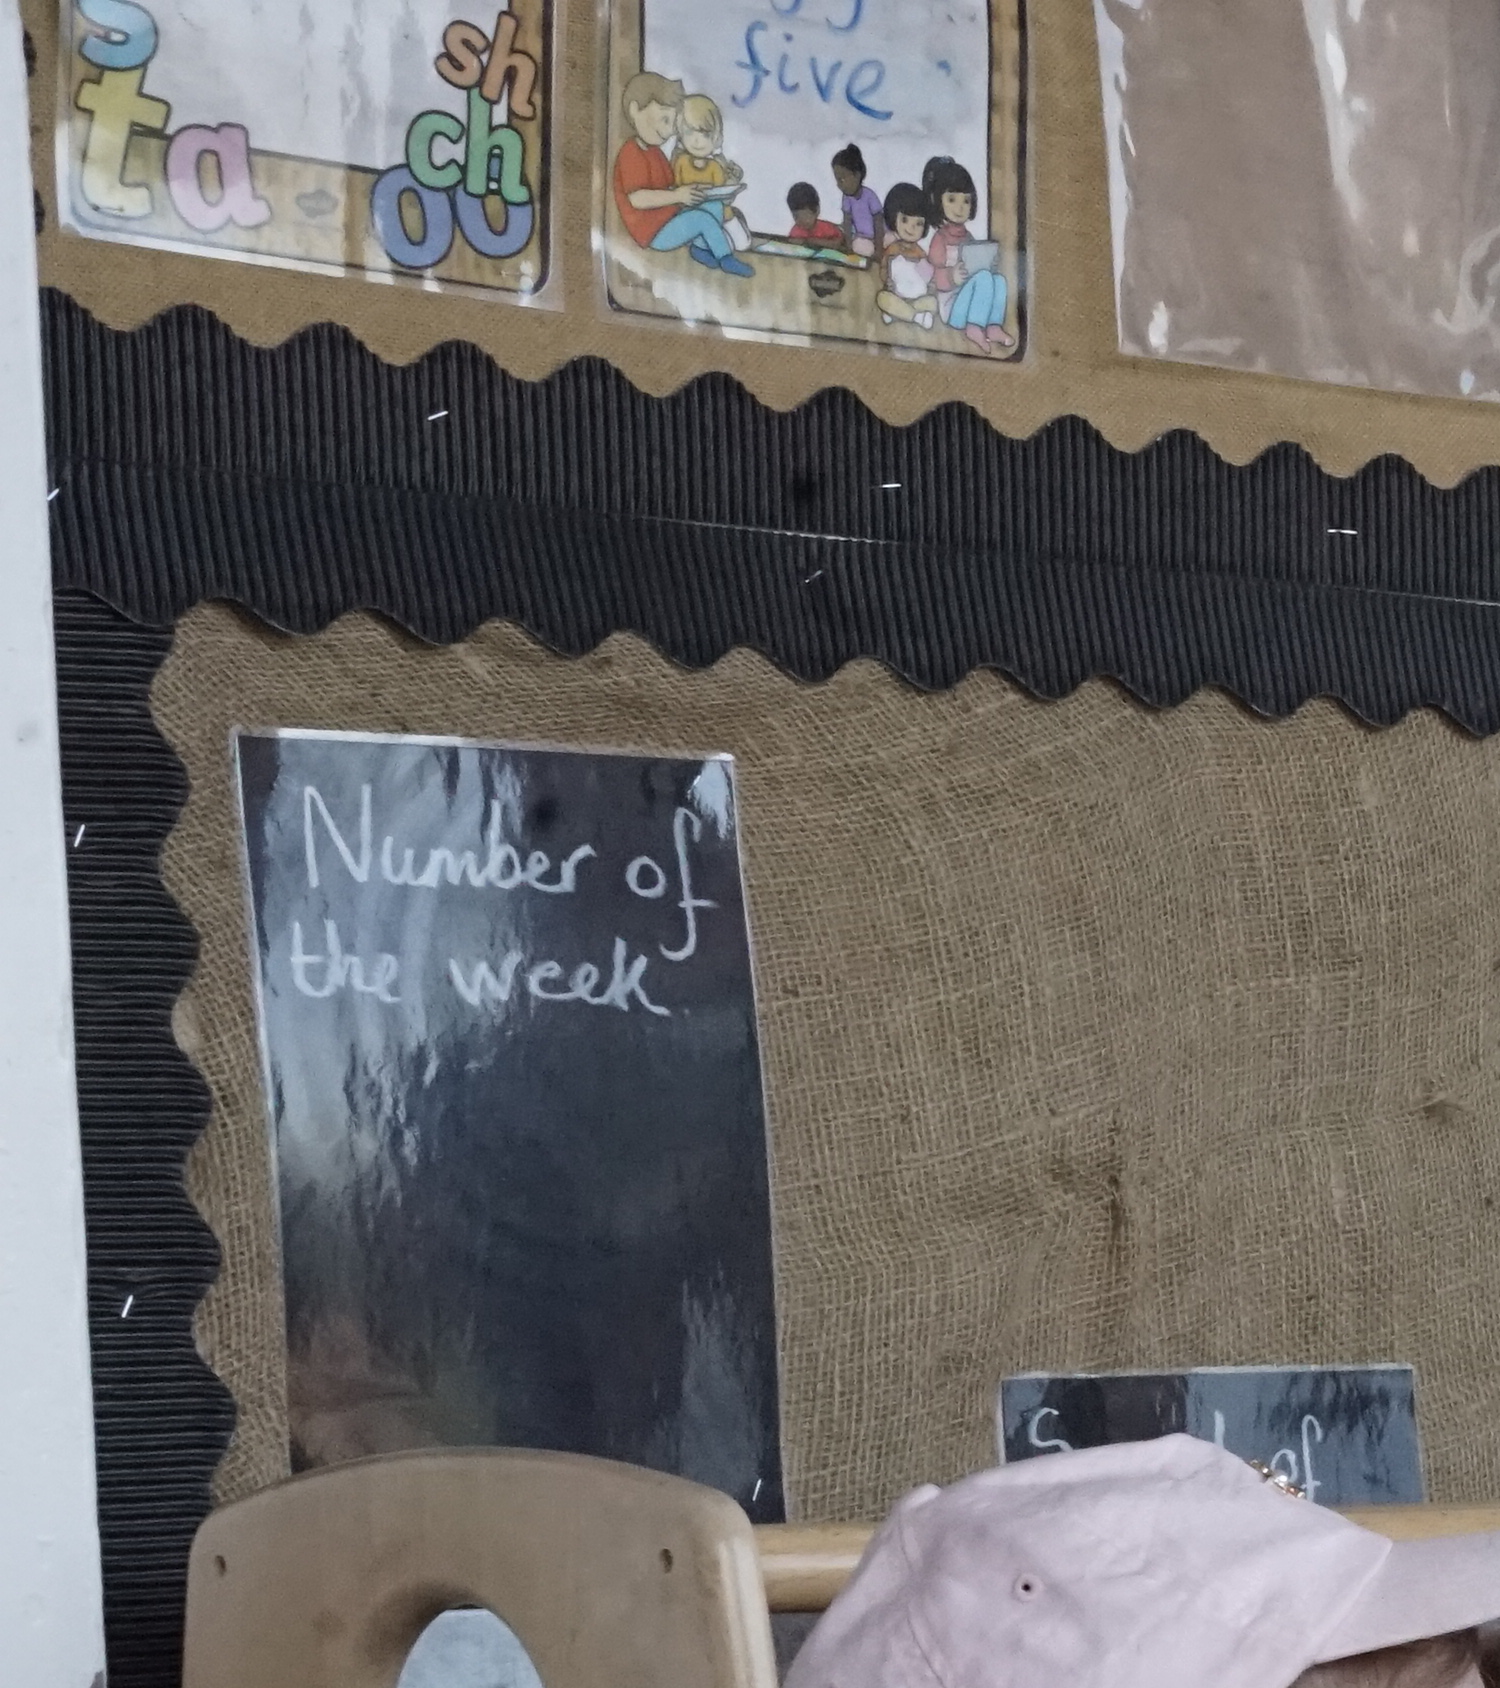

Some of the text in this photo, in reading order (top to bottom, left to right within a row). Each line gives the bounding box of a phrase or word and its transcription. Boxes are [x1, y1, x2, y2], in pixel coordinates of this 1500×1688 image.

[434, 11, 538, 120] sh
[732, 20, 893, 121] five
[405, 88, 531, 205] ch
[304, 783, 719, 962] Number of
[291, 919, 672, 1018] the week
